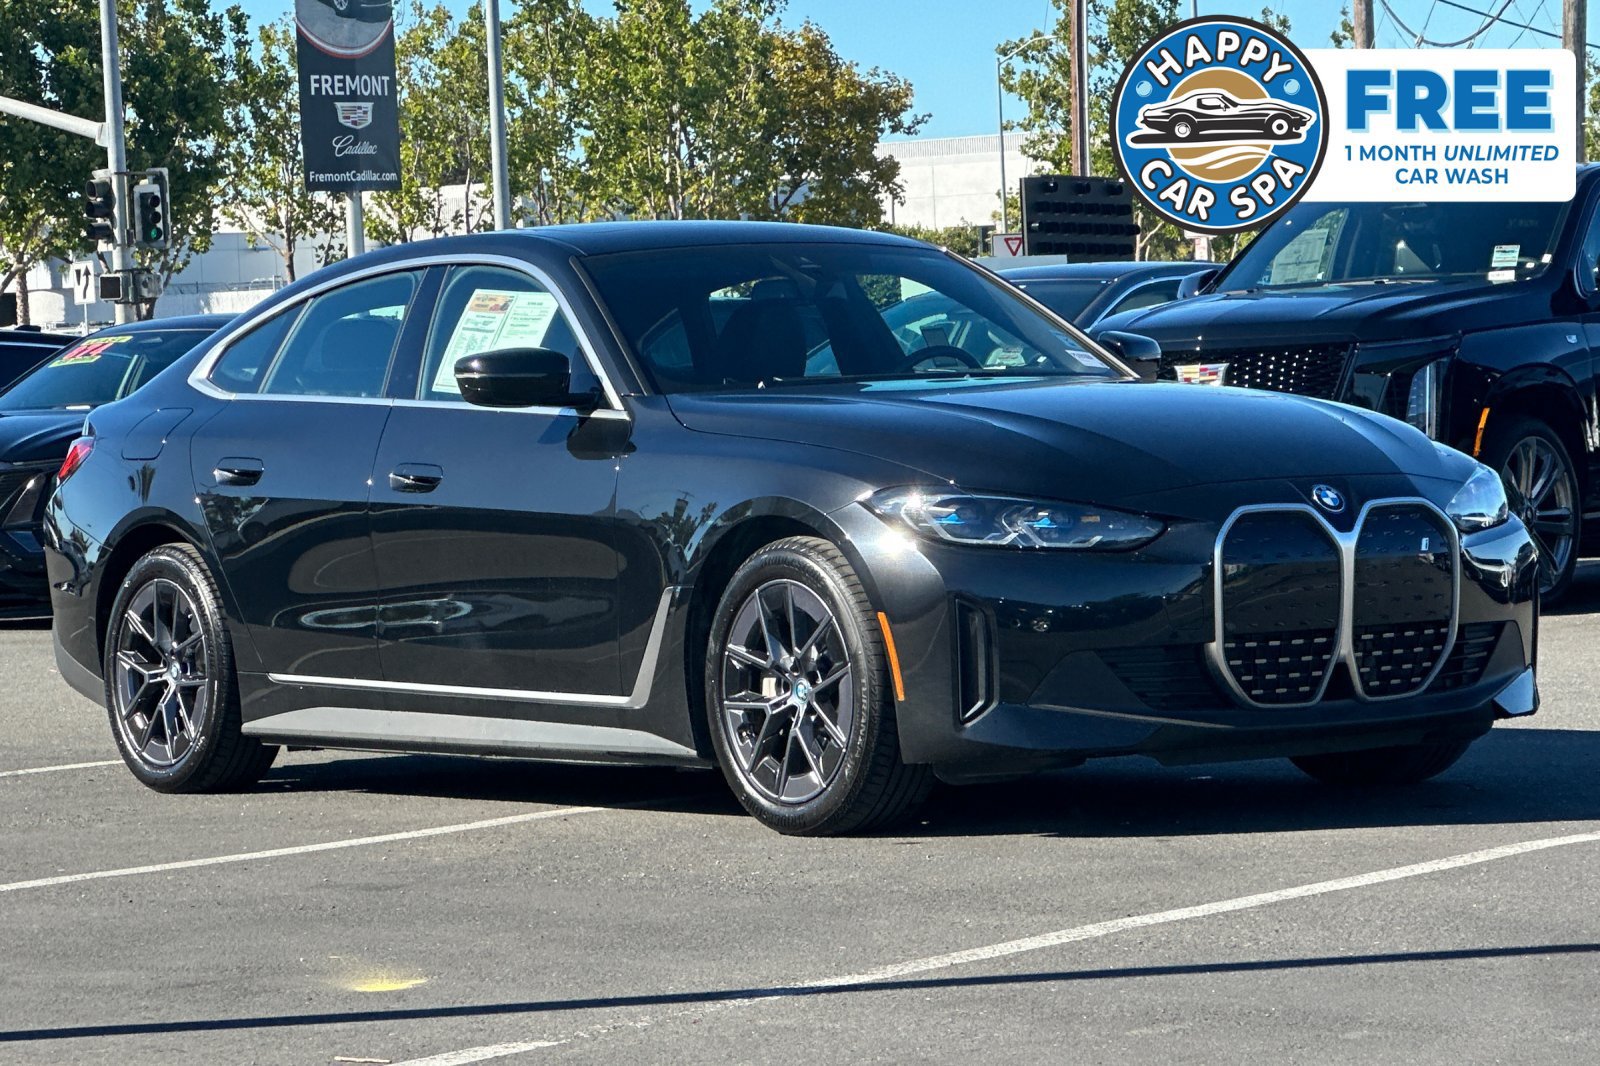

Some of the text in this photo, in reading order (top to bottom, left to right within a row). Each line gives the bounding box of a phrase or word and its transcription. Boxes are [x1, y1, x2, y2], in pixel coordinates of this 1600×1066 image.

[310, 75, 390, 96] FREMONT
[332, 134, 377, 157] Cadillac
[309, 169, 397, 182] FremontCadillac.com
